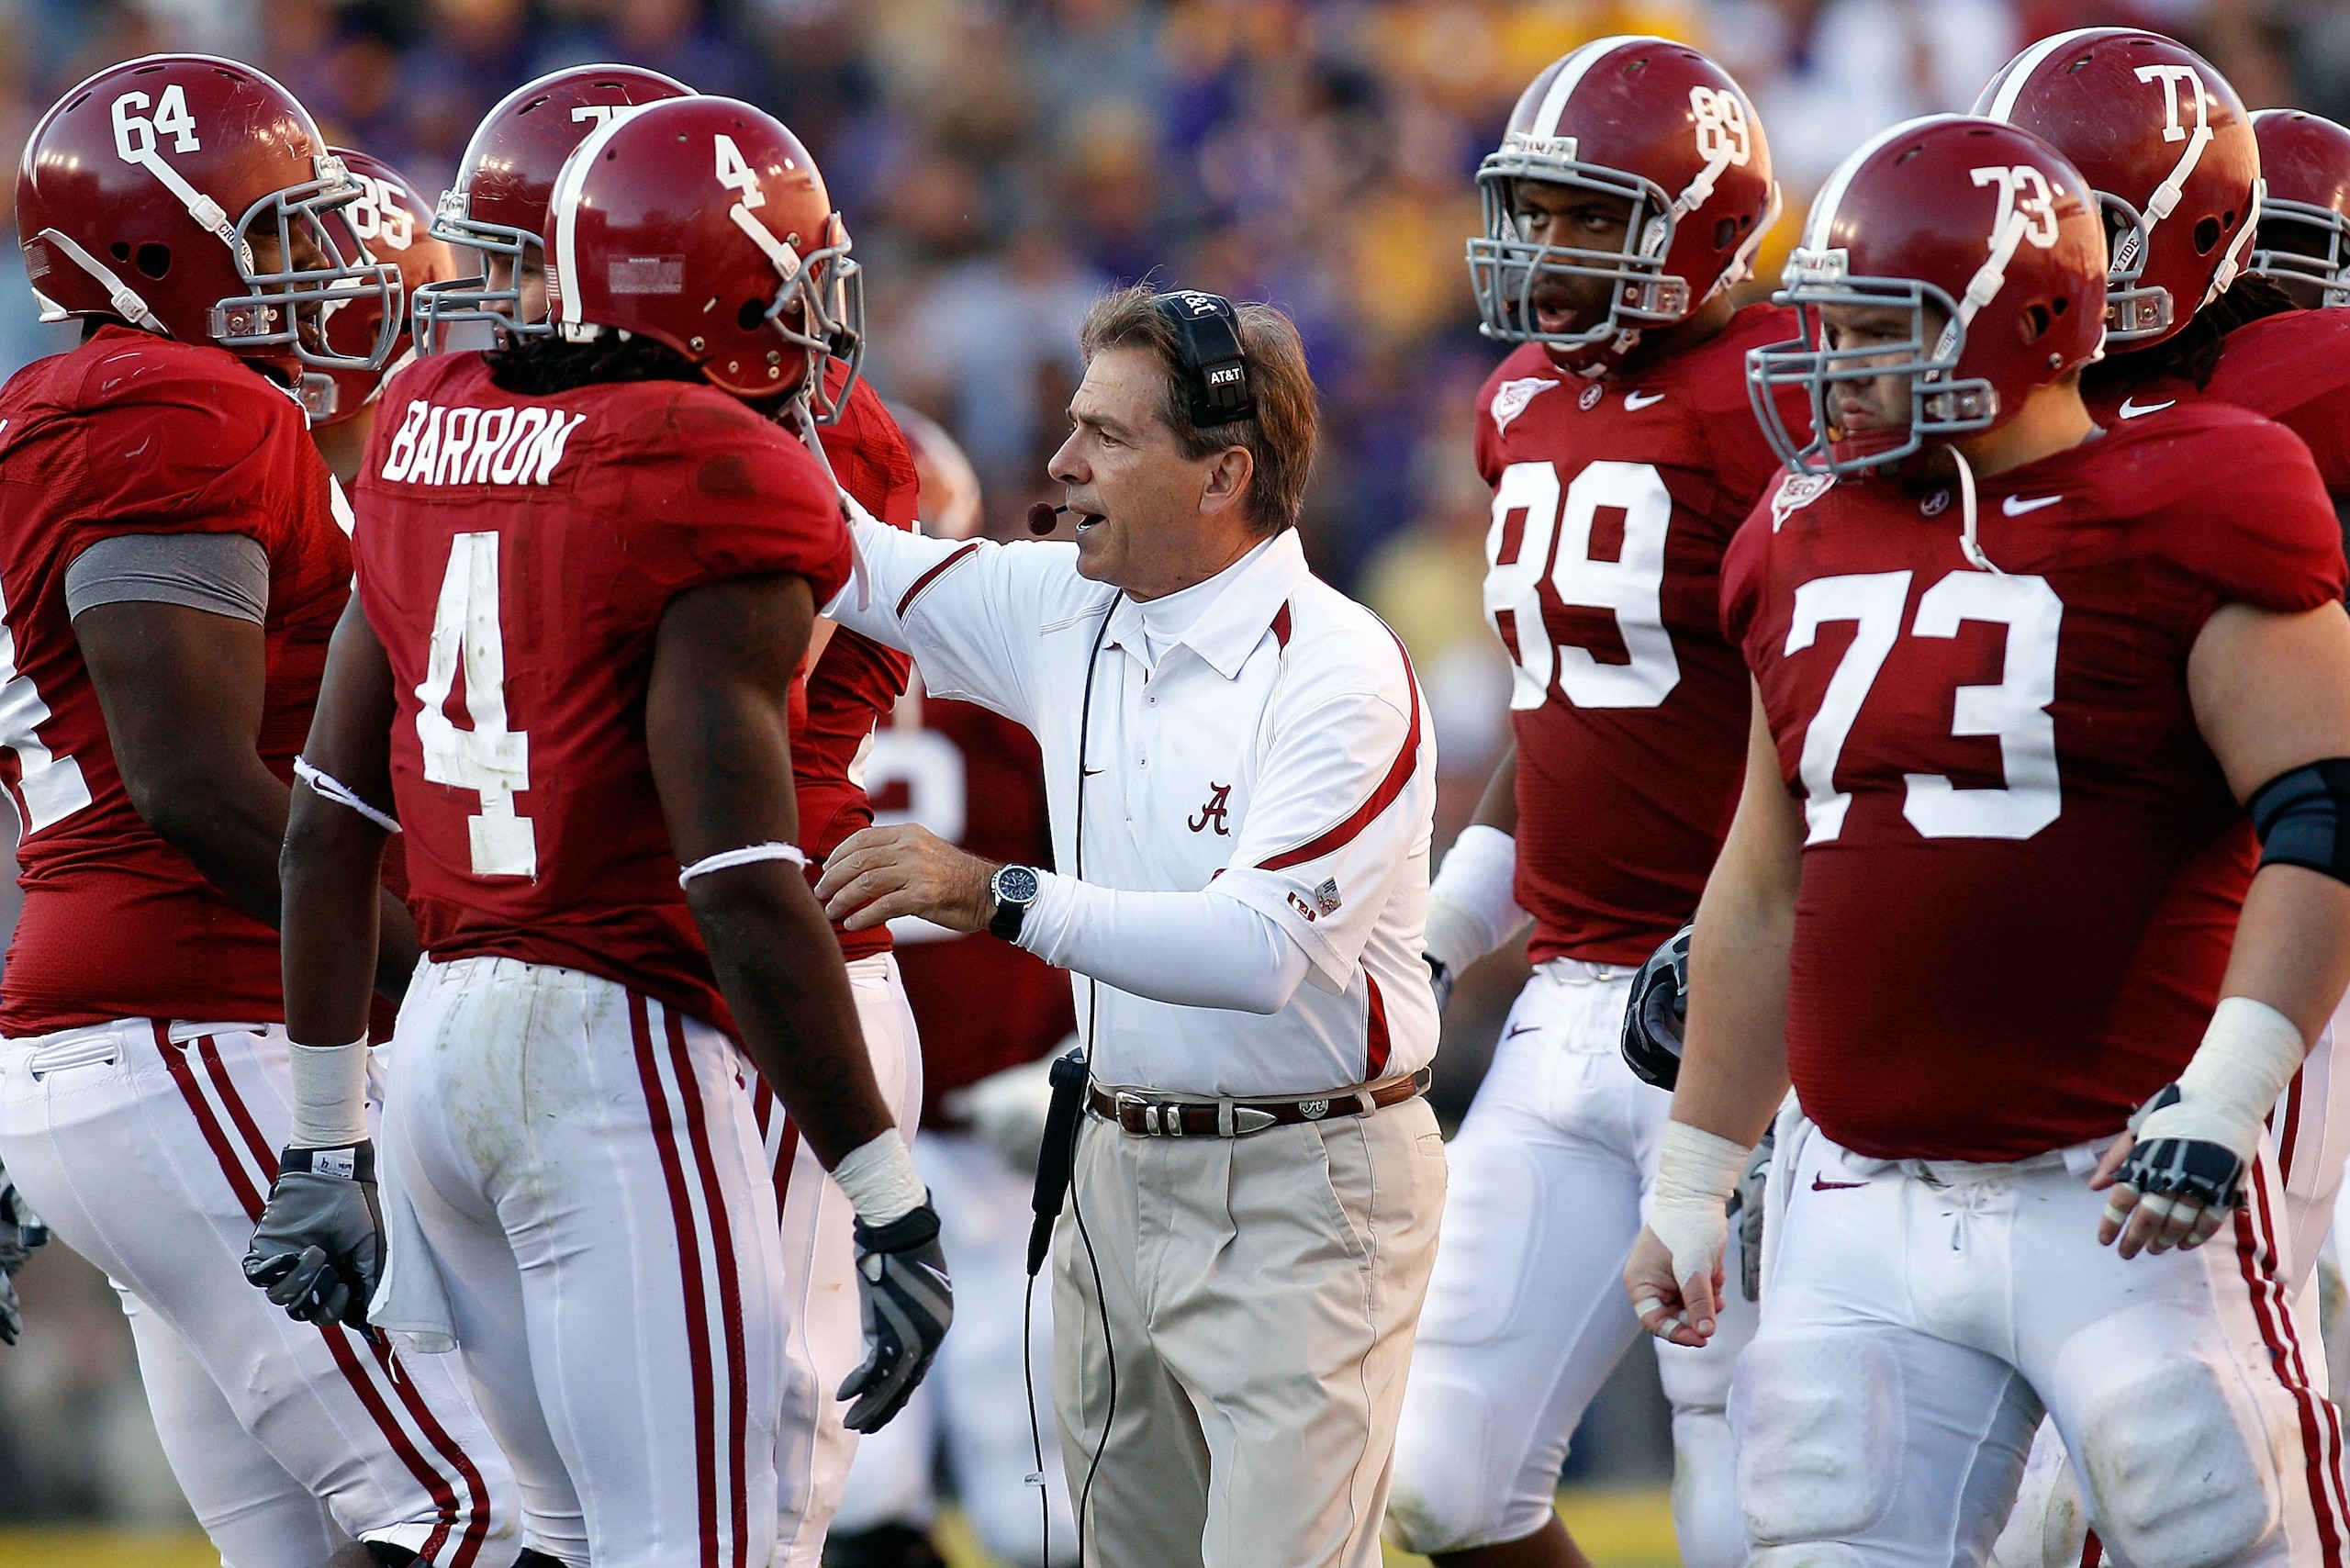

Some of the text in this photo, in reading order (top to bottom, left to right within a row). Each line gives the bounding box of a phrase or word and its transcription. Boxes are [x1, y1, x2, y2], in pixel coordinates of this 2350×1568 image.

[111, 84, 200, 164] 64
[1689, 84, 1751, 166] 89
[2133, 64, 2213, 142] 77
[714, 133, 766, 210] 4
[1969, 164, 2059, 250] 73
[345, 172, 414, 252] 85
[2117, 237, 2141, 264] TIDE
[1211, 367, 1240, 385] AT&T
[381, 399, 588, 487] BARRON
[1483, 460, 1681, 711] 89
[415, 530, 537, 876] 4
[1785, 570, 2065, 846] 73
[1188, 780, 1232, 836] A
